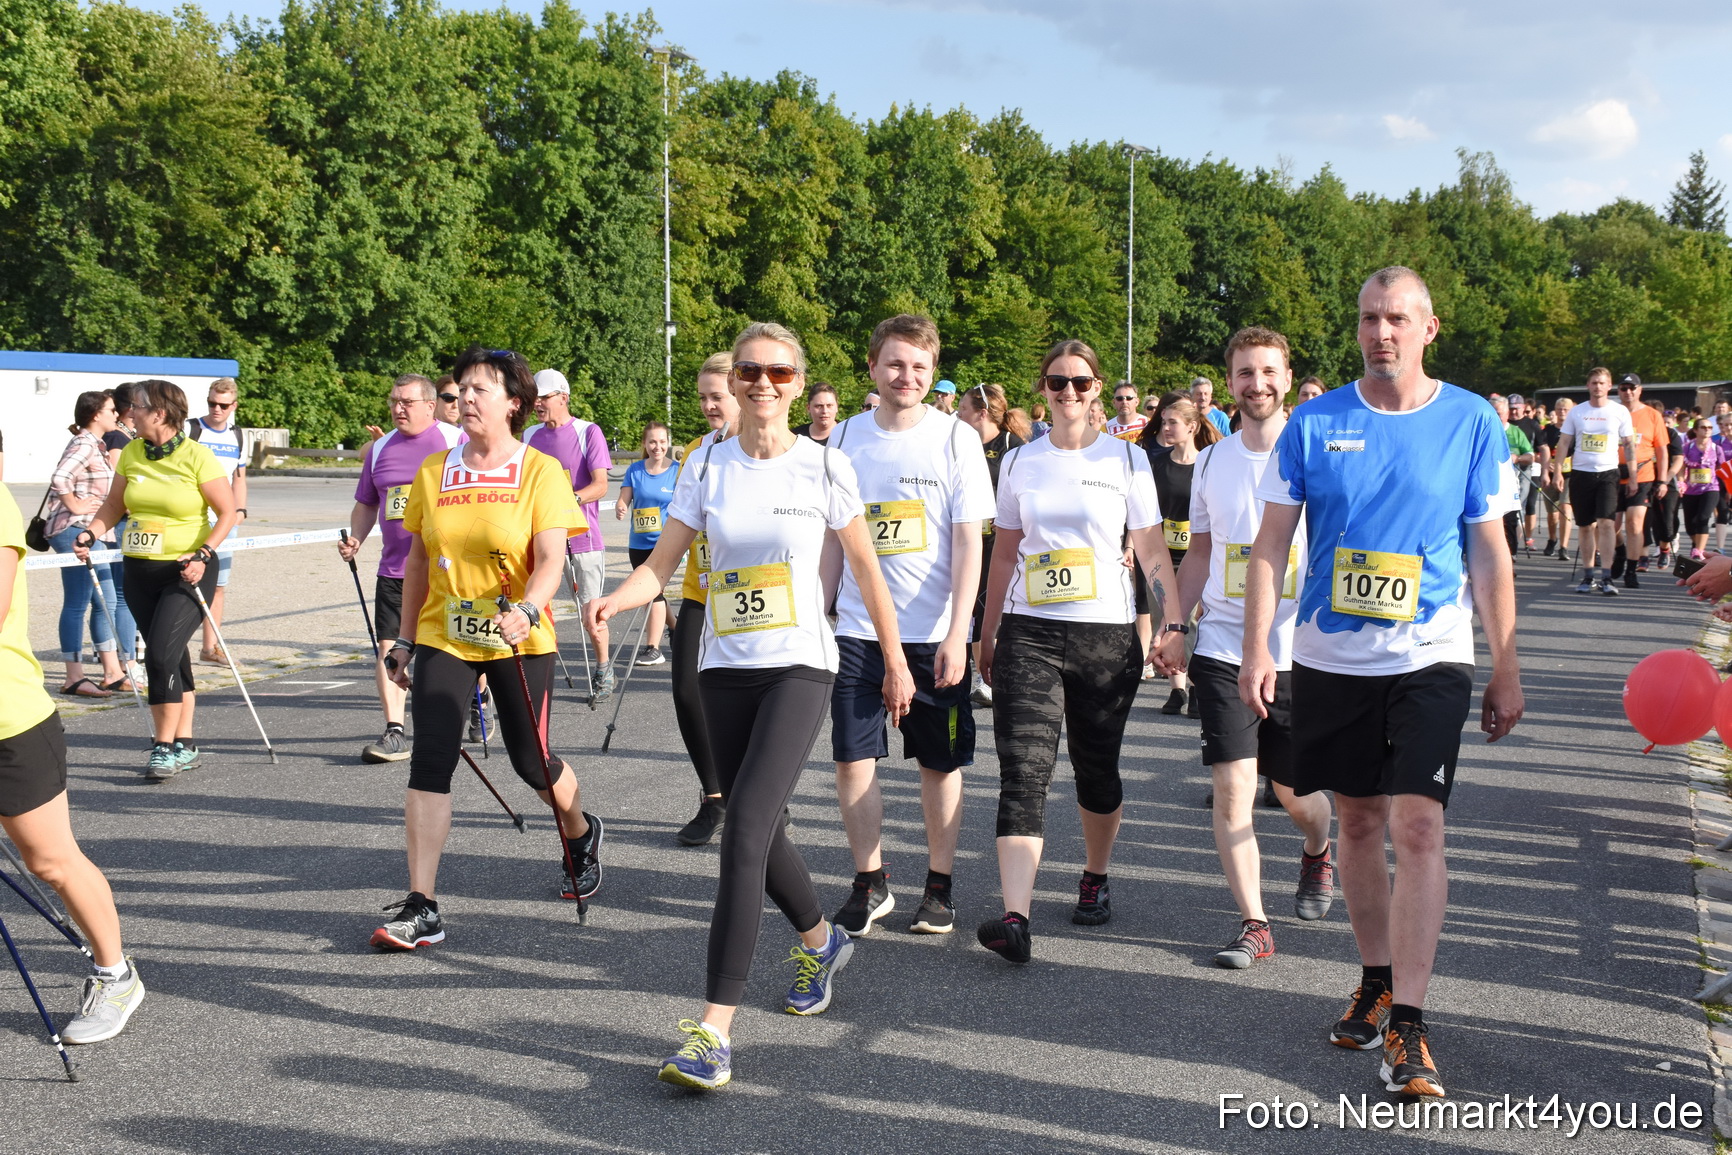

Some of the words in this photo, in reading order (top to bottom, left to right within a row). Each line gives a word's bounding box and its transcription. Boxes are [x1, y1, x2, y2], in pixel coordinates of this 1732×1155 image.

[899, 476, 938, 487] auctores
[1082, 479, 1119, 491] auctores
[437, 494, 471, 507] MAX
[477, 491, 519, 503] BÖGL
[773, 507, 817, 518] auctores
[636, 516, 657, 526] 1079
[877, 520, 902, 540] 27
[1173, 531, 1188, 542] 76
[128, 532, 158, 546] 1307
[1046, 568, 1071, 588] 30
[1343, 572, 1406, 601] 1070
[735, 589, 765, 615] 35
[1343, 596, 1376, 605] Guthmann
[1378, 600, 1403, 609] Markus
[731, 615, 748, 623] Weigl
[750, 613, 774, 621] Martina
